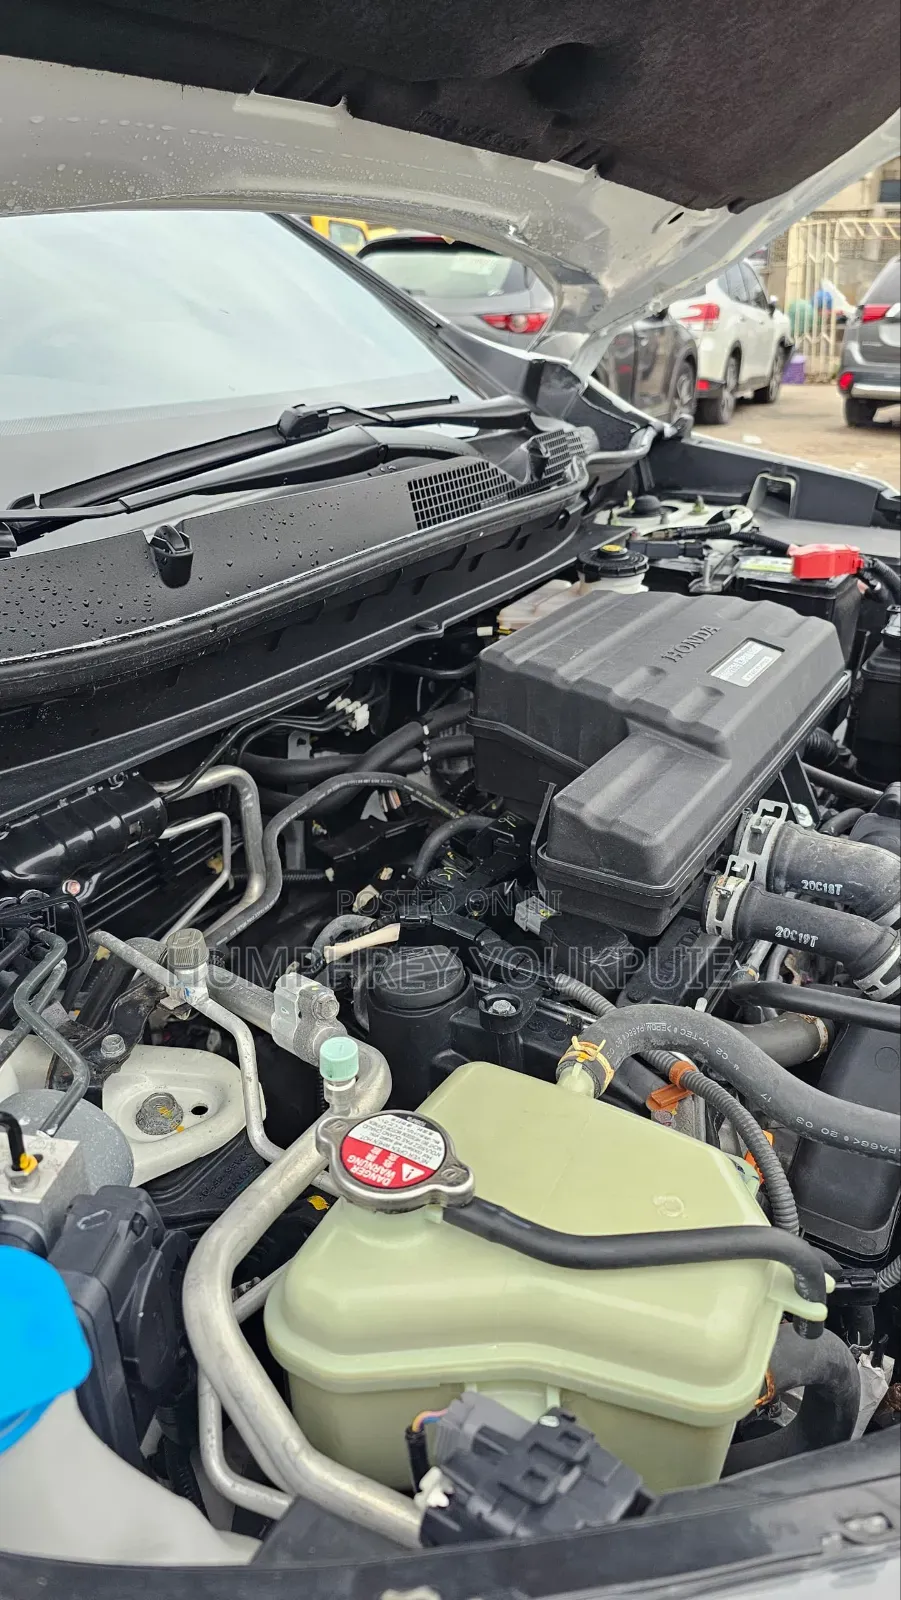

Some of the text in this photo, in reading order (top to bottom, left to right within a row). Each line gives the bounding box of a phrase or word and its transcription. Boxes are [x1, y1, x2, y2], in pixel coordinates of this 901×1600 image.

[661, 624, 721, 663] HONDA
[800, 879, 843, 896] 20C18T
[774, 925, 818, 948] 20C19T
[347, 1154, 397, 1179] WARNUNG
[349, 1164, 391, 1187] DANGER
